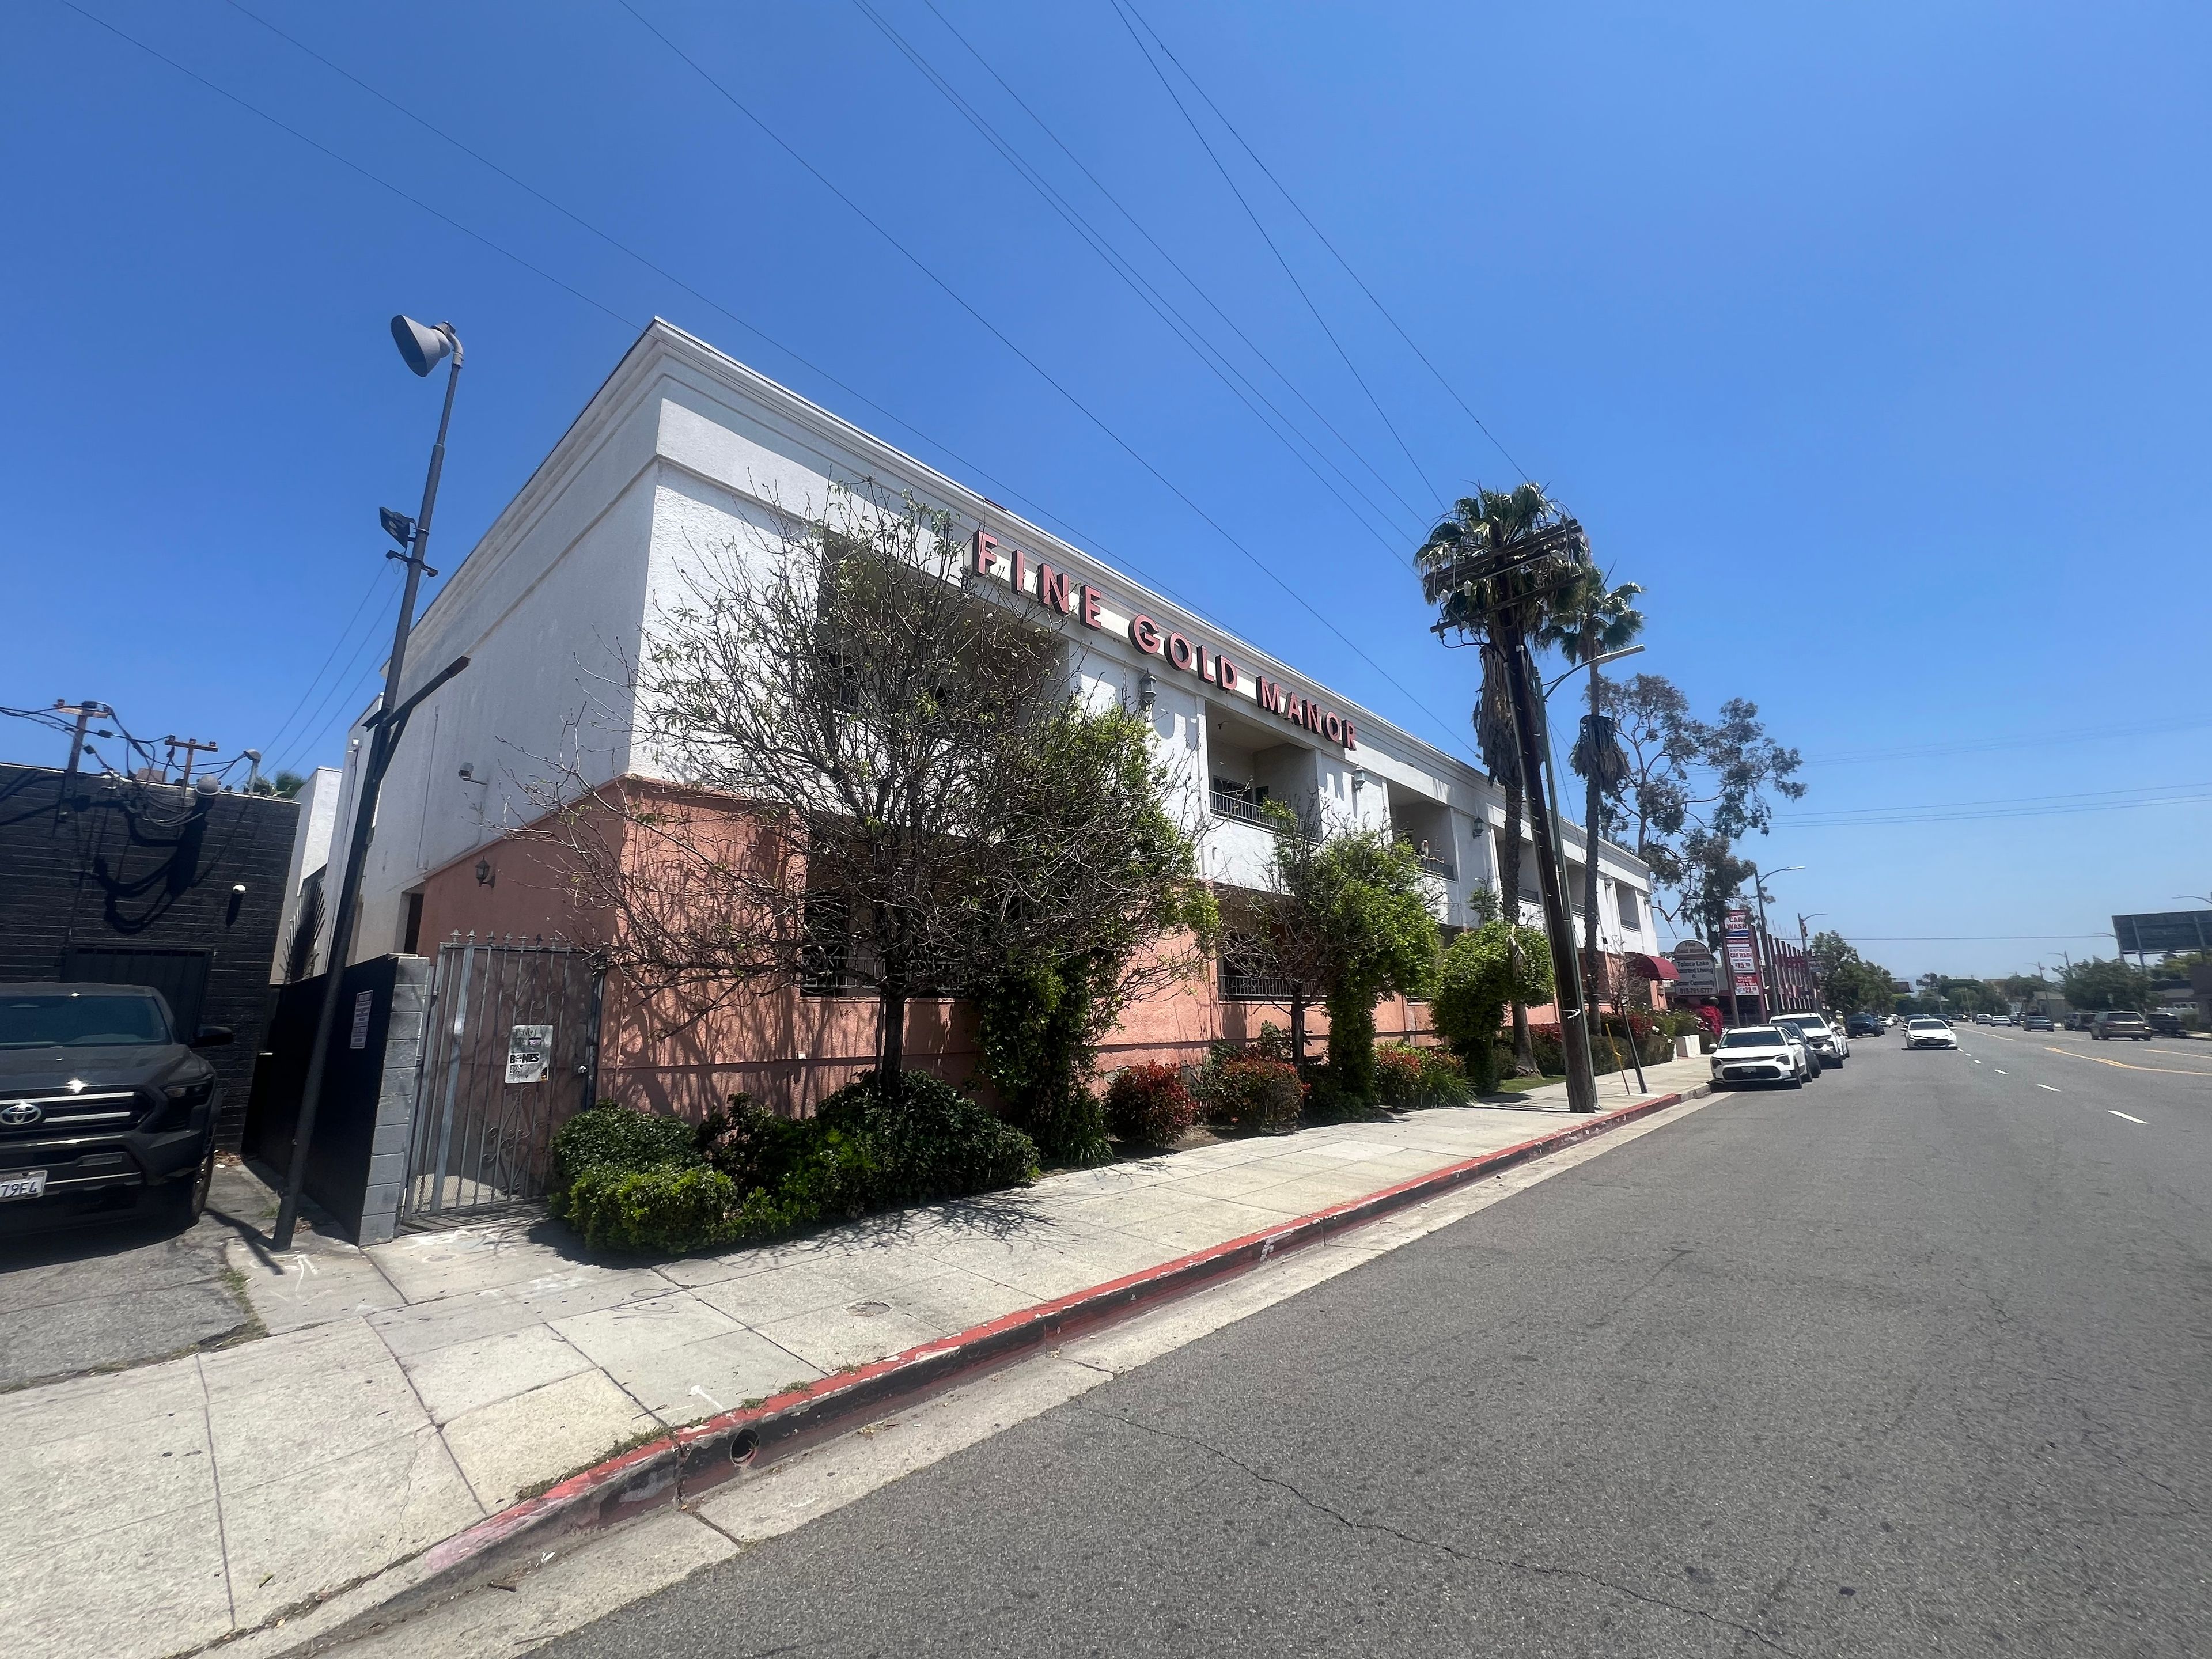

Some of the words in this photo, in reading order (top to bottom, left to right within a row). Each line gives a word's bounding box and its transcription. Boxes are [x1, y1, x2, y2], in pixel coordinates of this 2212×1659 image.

[973, 530, 1101, 631] FINE
[1128, 614, 1237, 691] GOLD
[1256, 675, 1357, 751] MANOR
